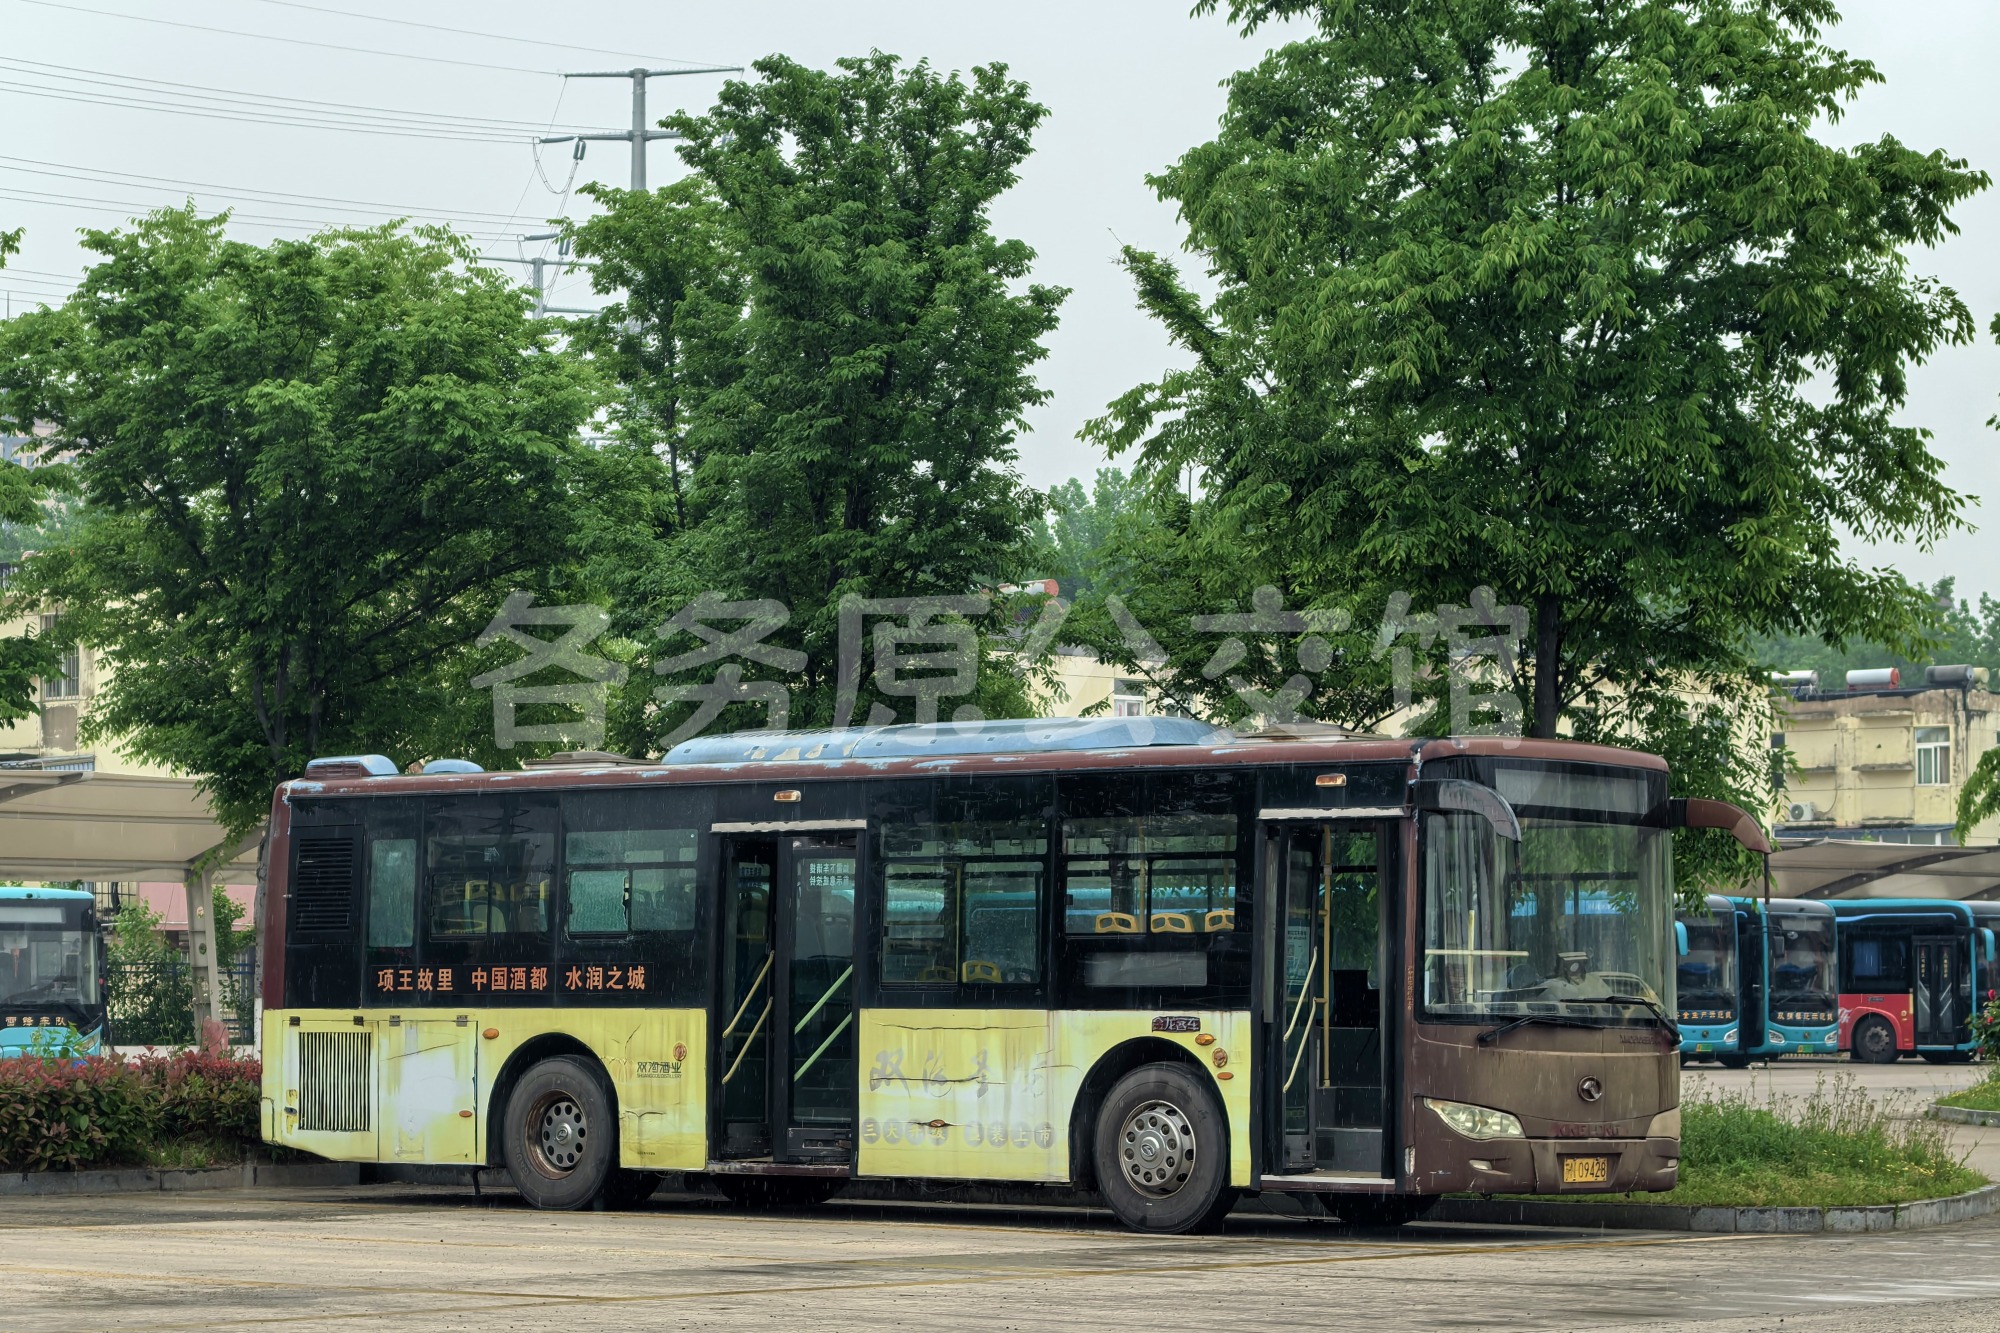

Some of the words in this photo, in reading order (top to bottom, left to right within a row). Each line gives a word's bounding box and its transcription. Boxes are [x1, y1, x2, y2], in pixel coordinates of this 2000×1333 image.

[377, 967, 454, 992] 项王故里
[471, 966, 548, 991] 中国酒都
[565, 965, 646, 991] 水润之城
